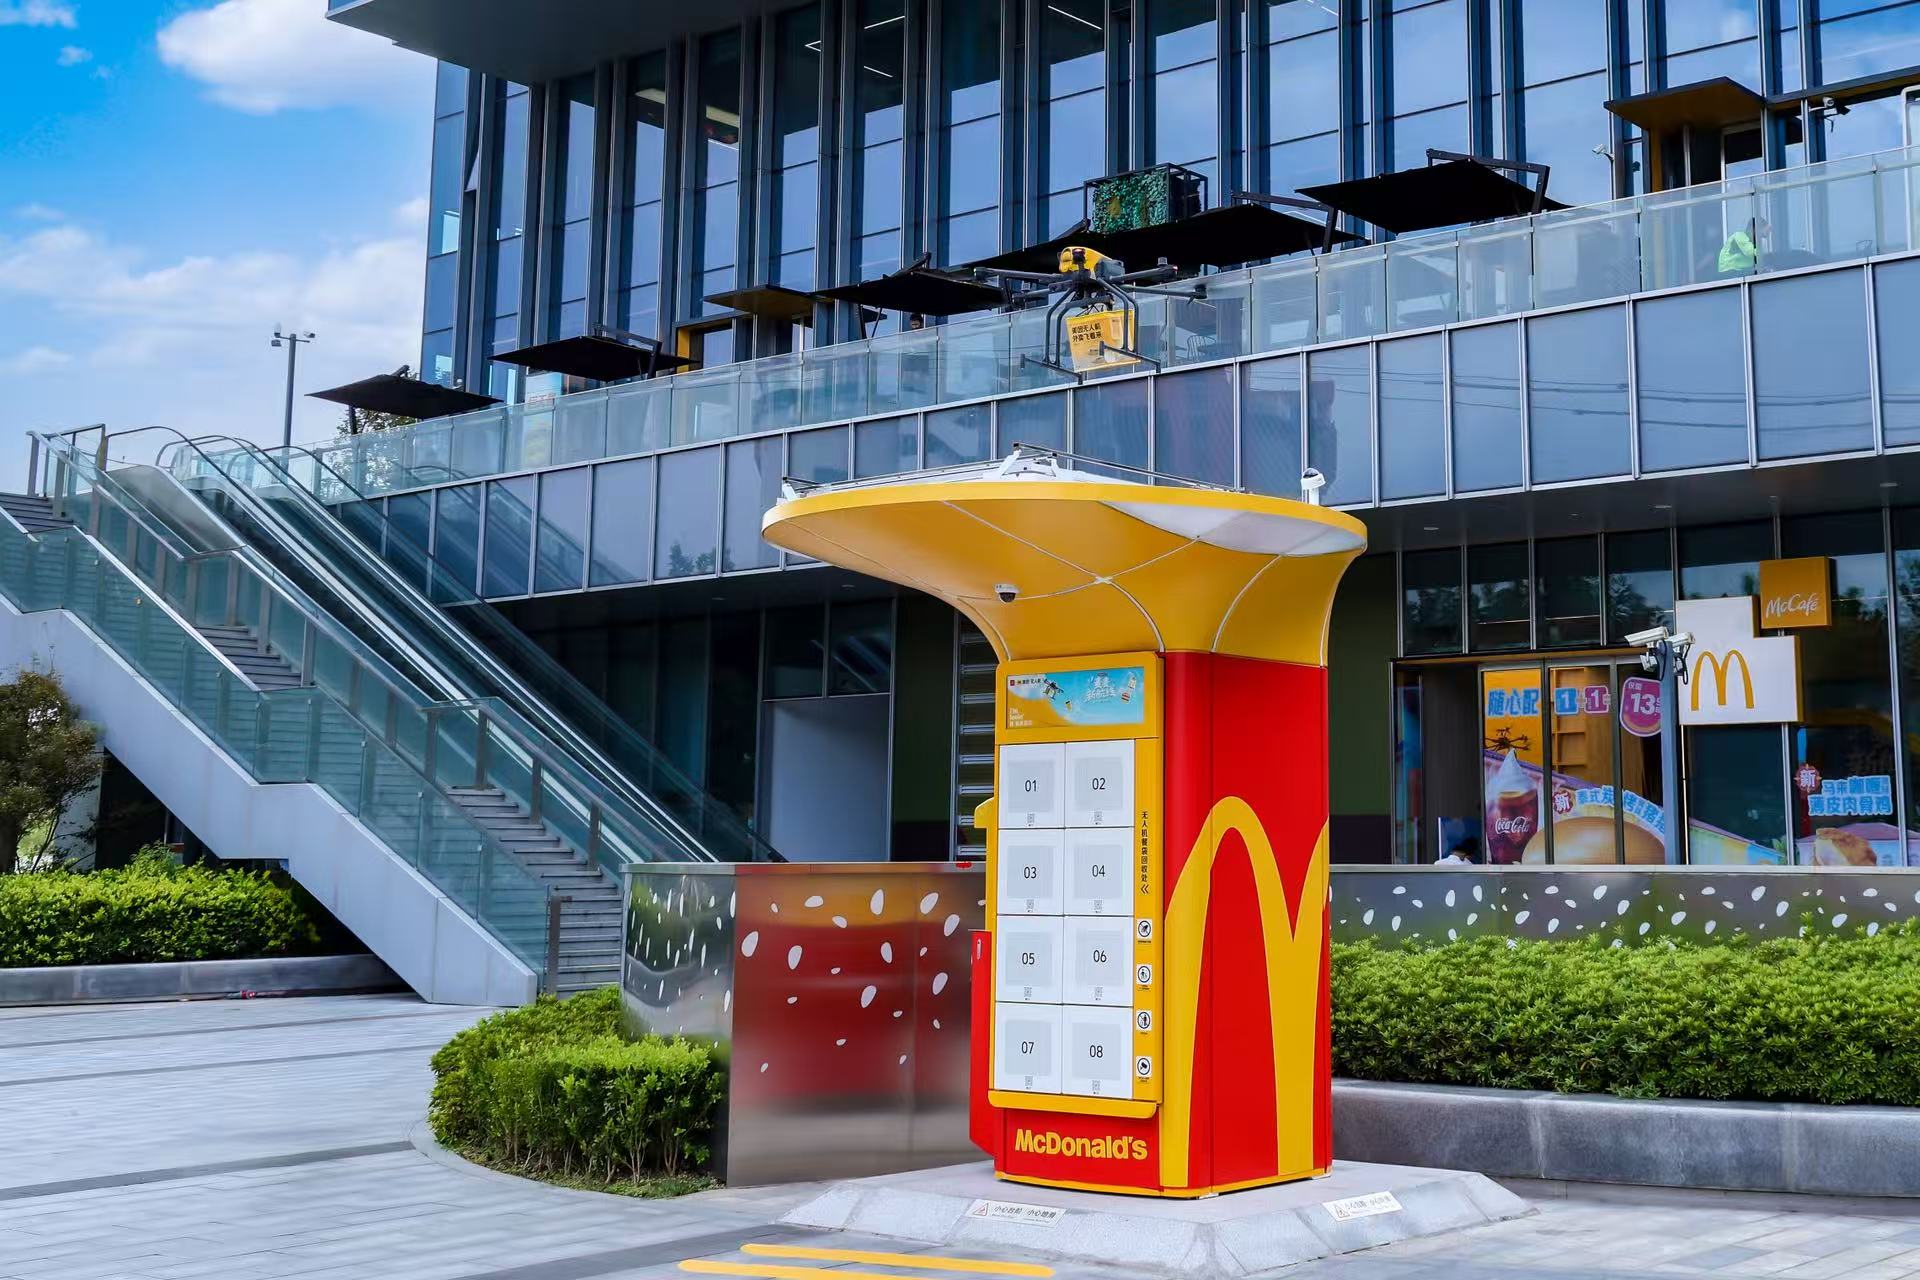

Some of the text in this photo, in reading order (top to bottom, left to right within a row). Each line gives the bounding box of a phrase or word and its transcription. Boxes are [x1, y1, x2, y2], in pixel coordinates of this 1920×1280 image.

[1766, 593, 1818, 618] McCafé
[1488, 688, 1540, 717] 随心配
[1092, 777, 1106, 790] 02
[1801, 770, 1816, 787] 新
[1025, 780, 1037, 792] 01
[1554, 792, 1571, 813] 新
[1141, 811, 1149, 882] 无人机餐袋回收处
[1023, 866, 1037, 879] 03
[1092, 864, 1106, 878] 04
[1021, 952, 1035, 965] 05
[1093, 949, 1107, 963] 06
[1021, 1041, 1035, 1054] 07
[1089, 1044, 1104, 1058] 08
[1014, 1128, 1148, 1160] McDonald's
